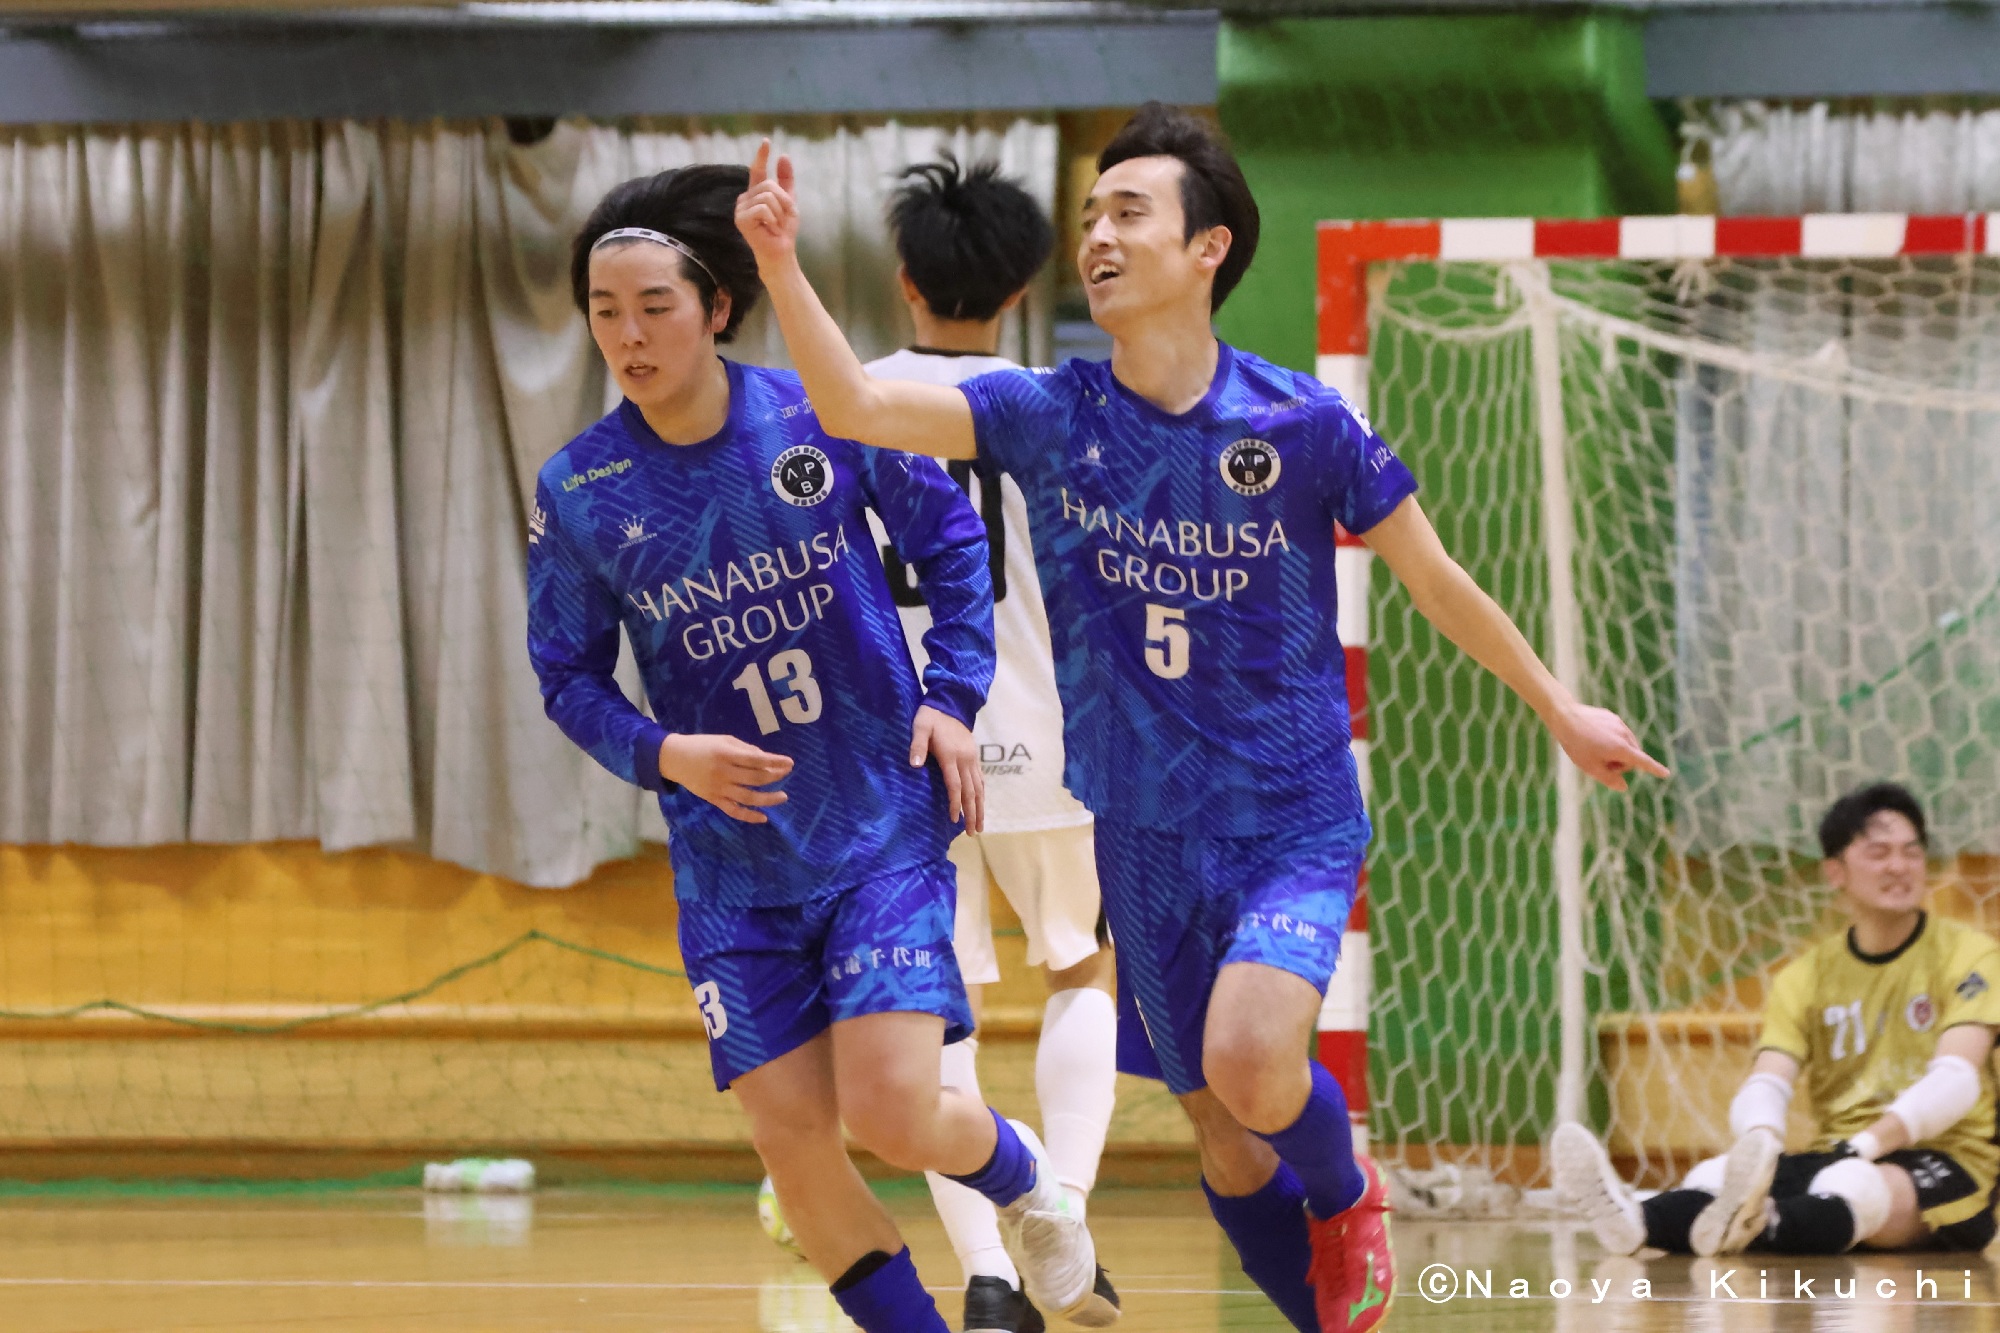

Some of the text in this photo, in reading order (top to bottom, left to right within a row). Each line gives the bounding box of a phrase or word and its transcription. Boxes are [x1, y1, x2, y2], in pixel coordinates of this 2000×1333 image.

[562, 458, 632, 492] Life Design
[1061, 487, 1291, 559] HANABUSA
[628, 524, 850, 621] HANABUSA
[1097, 548, 1249, 602] GROUP
[683, 584, 835, 660] GROUP
[1144, 603, 1190, 679] 5
[733, 649, 823, 736] 13
